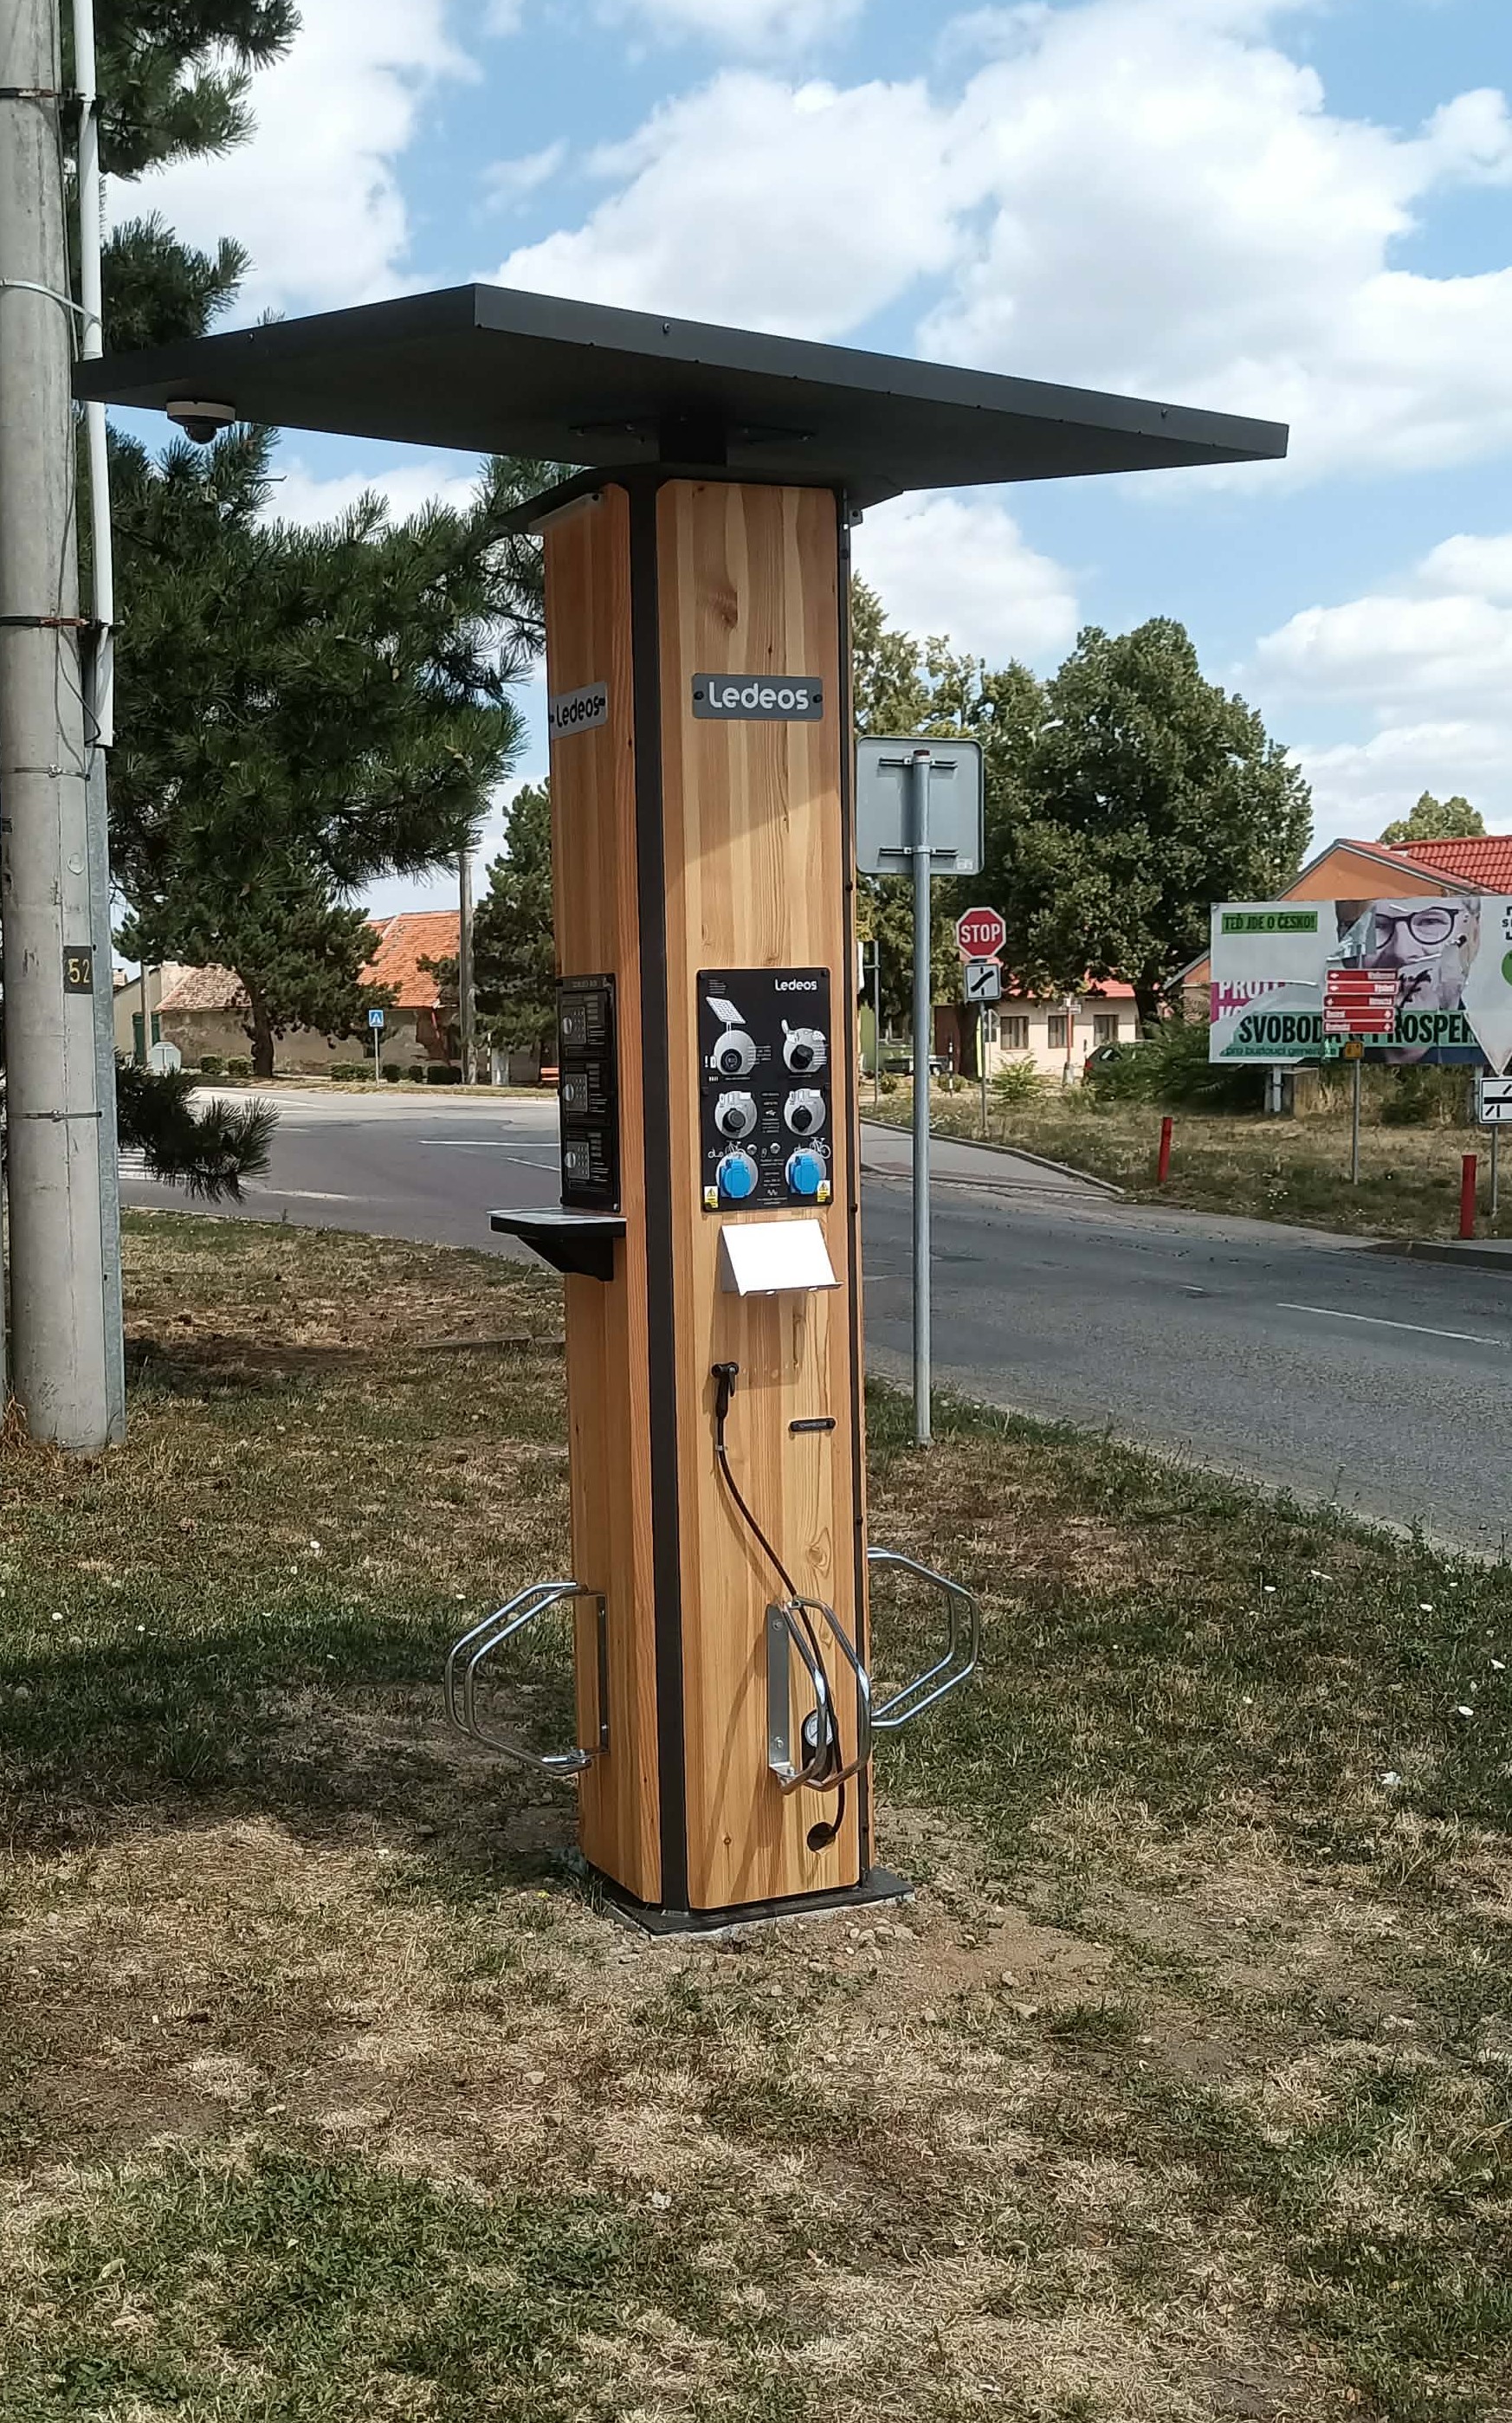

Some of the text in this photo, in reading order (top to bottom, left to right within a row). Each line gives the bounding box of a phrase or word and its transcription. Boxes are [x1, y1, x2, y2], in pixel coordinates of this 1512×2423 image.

[708, 682, 810, 710] Ledeos
[556, 695, 600, 727] Ledeos
[960, 923, 1000, 943] STOP
[1247, 916, 1264, 930] JDE
[1267, 916, 1275, 929] O
[68, 958, 90, 984] 52
[775, 979, 817, 991] Ledeos
